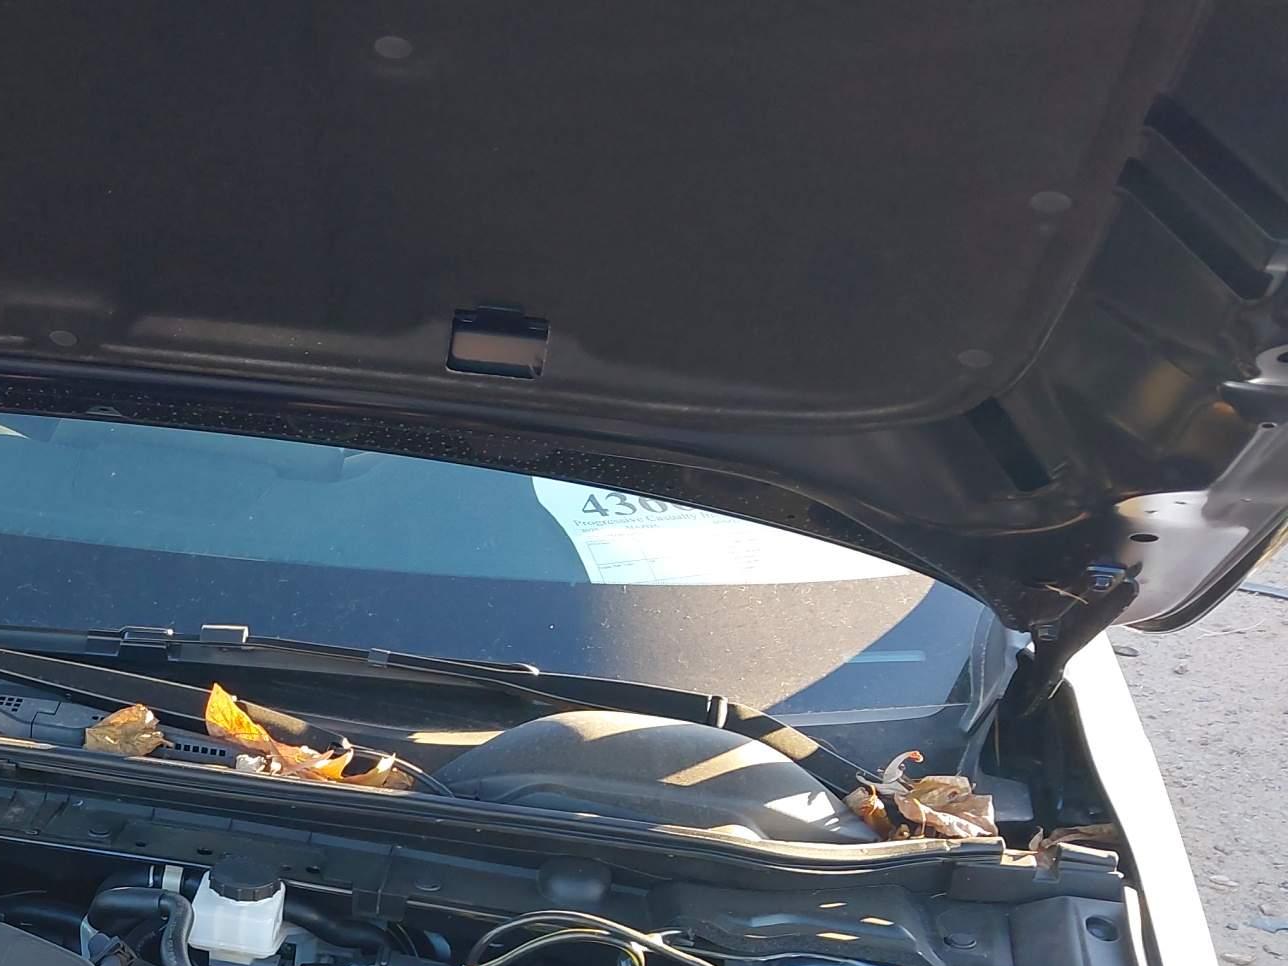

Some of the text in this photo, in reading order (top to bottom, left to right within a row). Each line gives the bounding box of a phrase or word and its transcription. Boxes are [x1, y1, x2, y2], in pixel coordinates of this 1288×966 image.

[582, 492, 694, 516] 436
[573, 517, 644, 527] Progressive
[645, 513, 697, 523] Casualty
